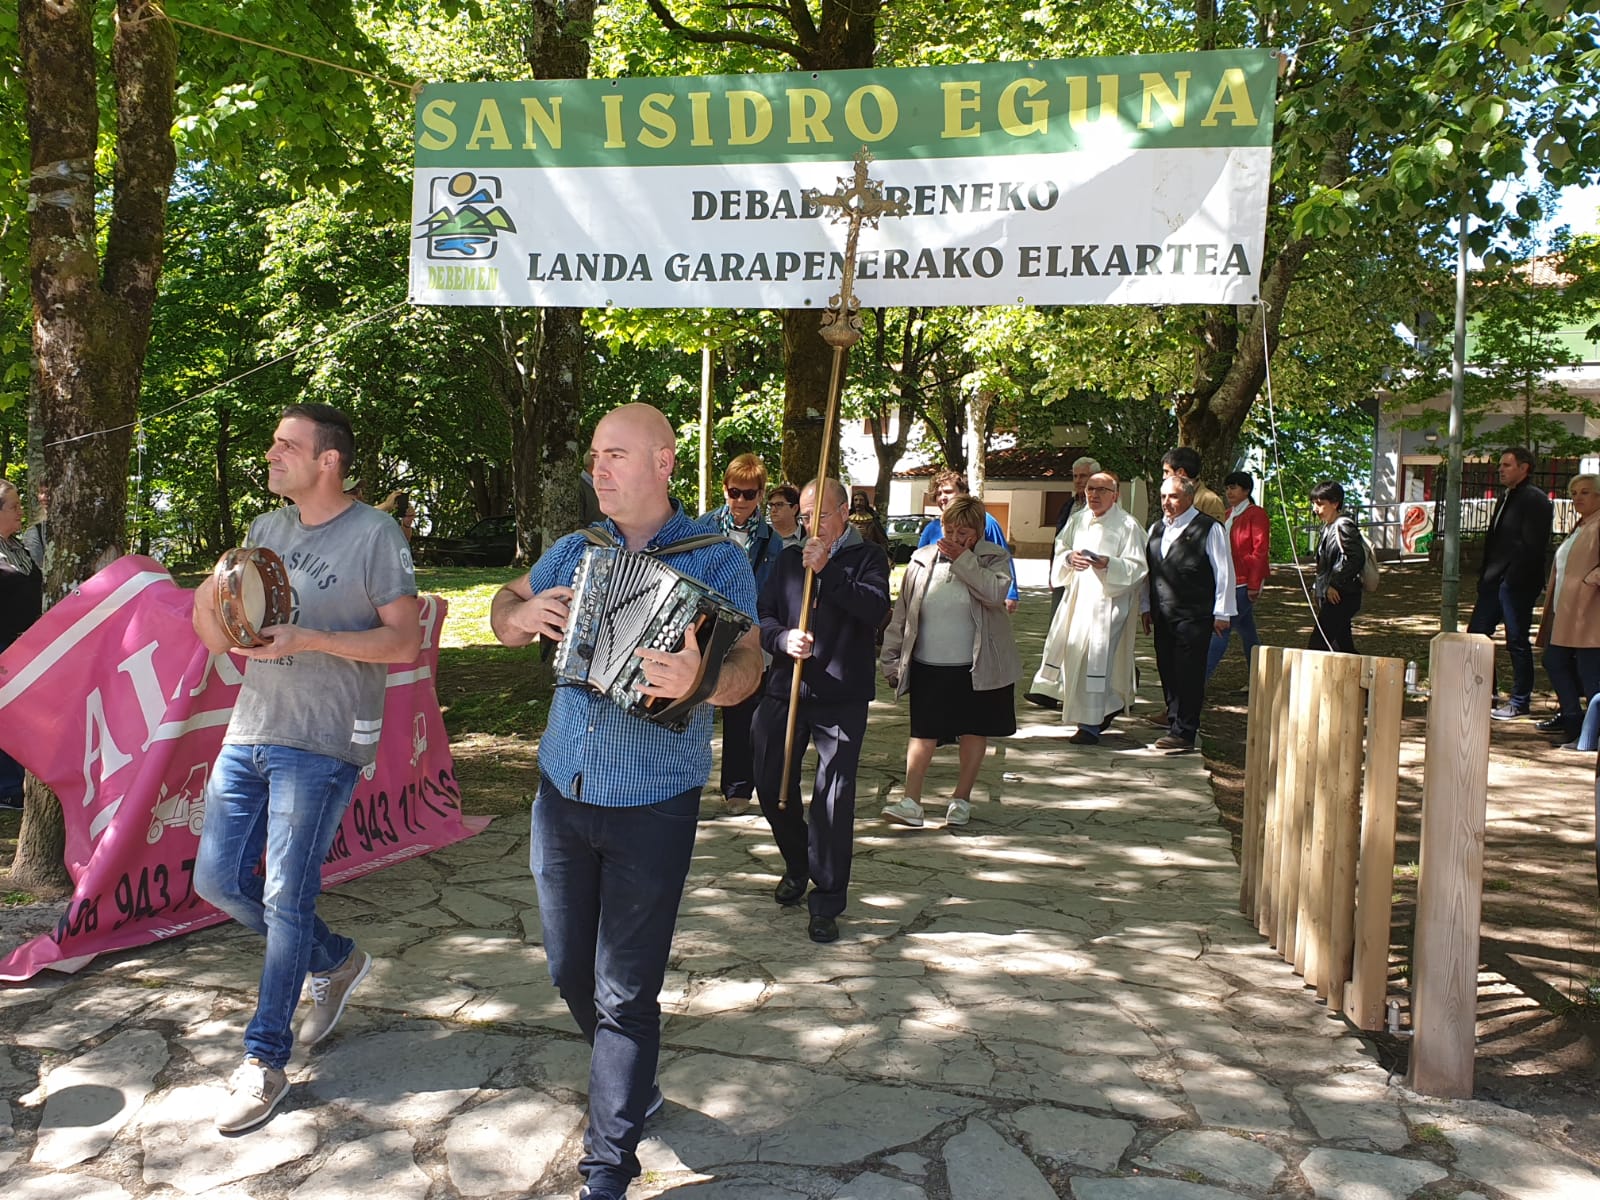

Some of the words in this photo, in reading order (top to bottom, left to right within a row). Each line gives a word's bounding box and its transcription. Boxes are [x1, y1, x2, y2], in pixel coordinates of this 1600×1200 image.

[416, 95, 563, 152] SAN
[600, 84, 899, 149] ISIDRO
[939, 67, 1258, 140] EGUNA
[691, 180, 1060, 221] DEBABRENEKO
[428, 265, 499, 291] DEBEMEN
[527, 252, 653, 282] LANDA
[664, 245, 1004, 282] GARAPENERAKO
[1017, 243, 1251, 279] ELKARTEA
[354, 791, 399, 852] 943
[113, 863, 171, 931] 943
